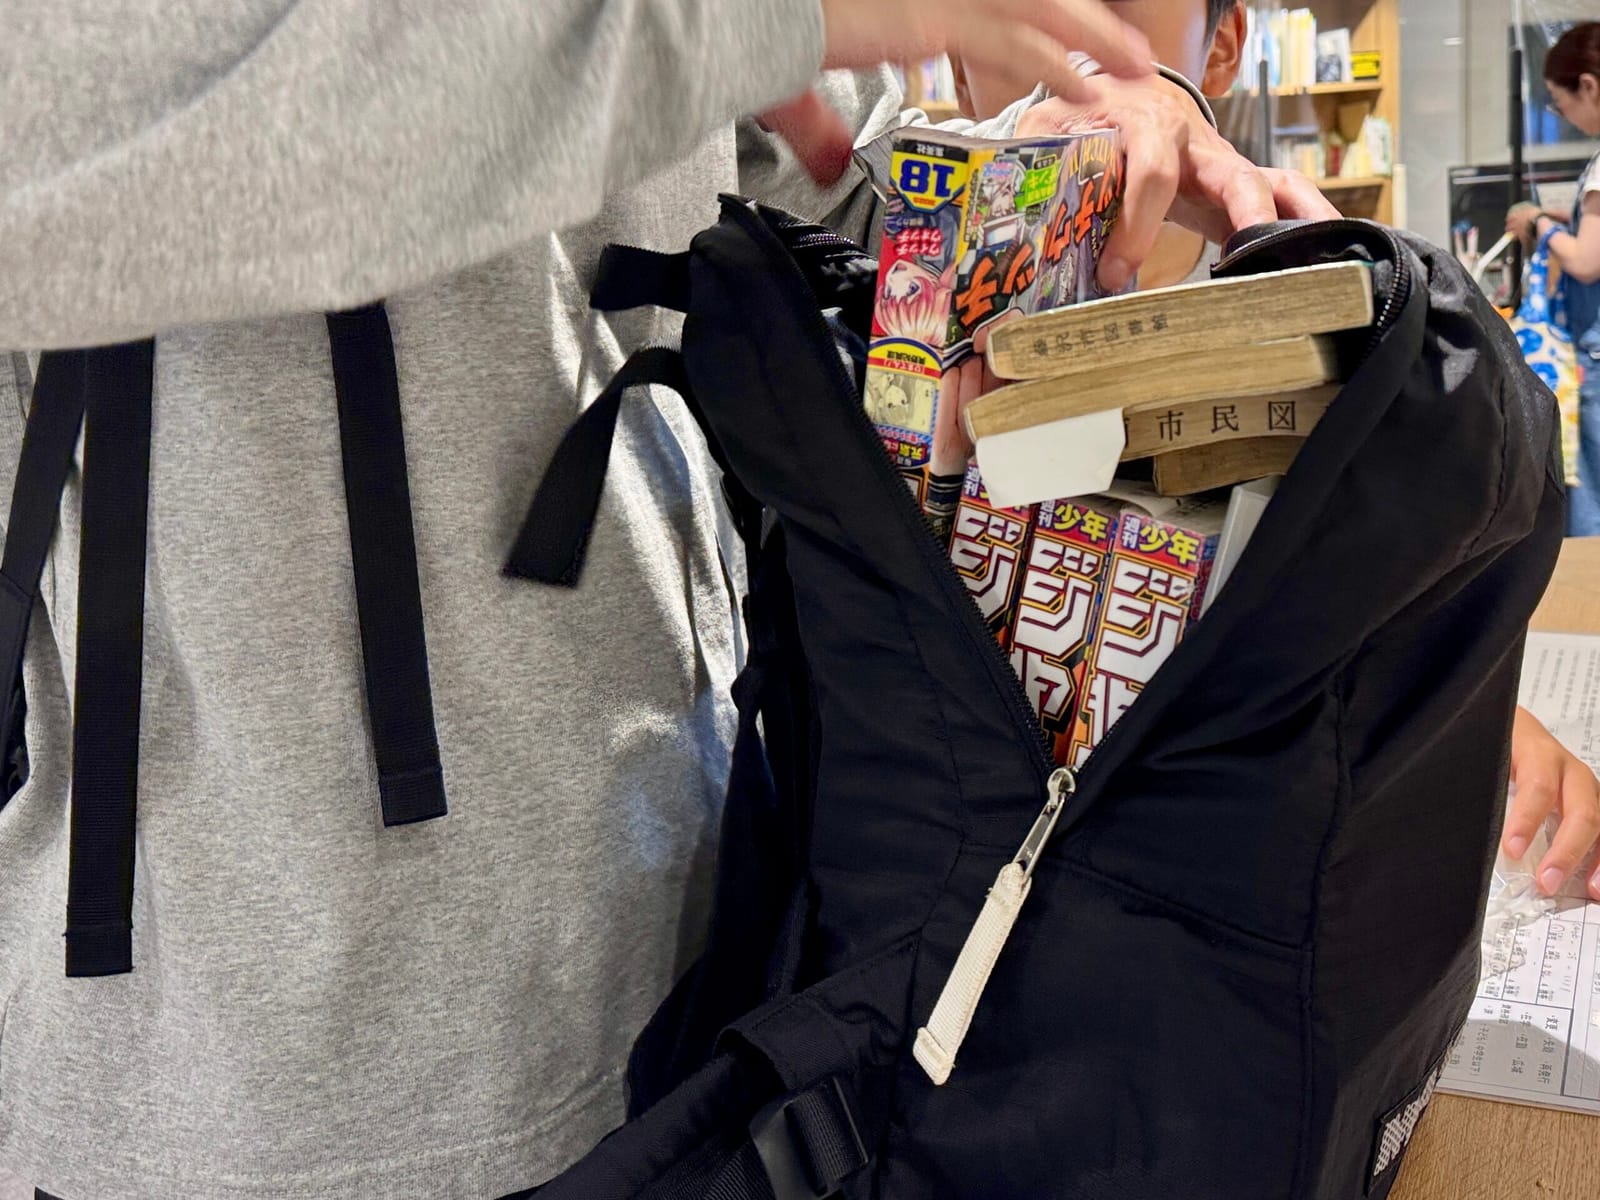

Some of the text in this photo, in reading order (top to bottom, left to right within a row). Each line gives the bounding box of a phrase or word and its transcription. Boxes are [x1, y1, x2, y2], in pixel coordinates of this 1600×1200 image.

[900, 159, 955, 198] 18
[896, 228, 941, 244] ウォッチ
[896, 242, 941, 256] ウィッチ
[1125, 401, 1296, 448] 市民図
[1053, 504, 1109, 542] 少年
[1121, 514, 1140, 549] 週刊
[1139, 524, 1200, 565] 少年
